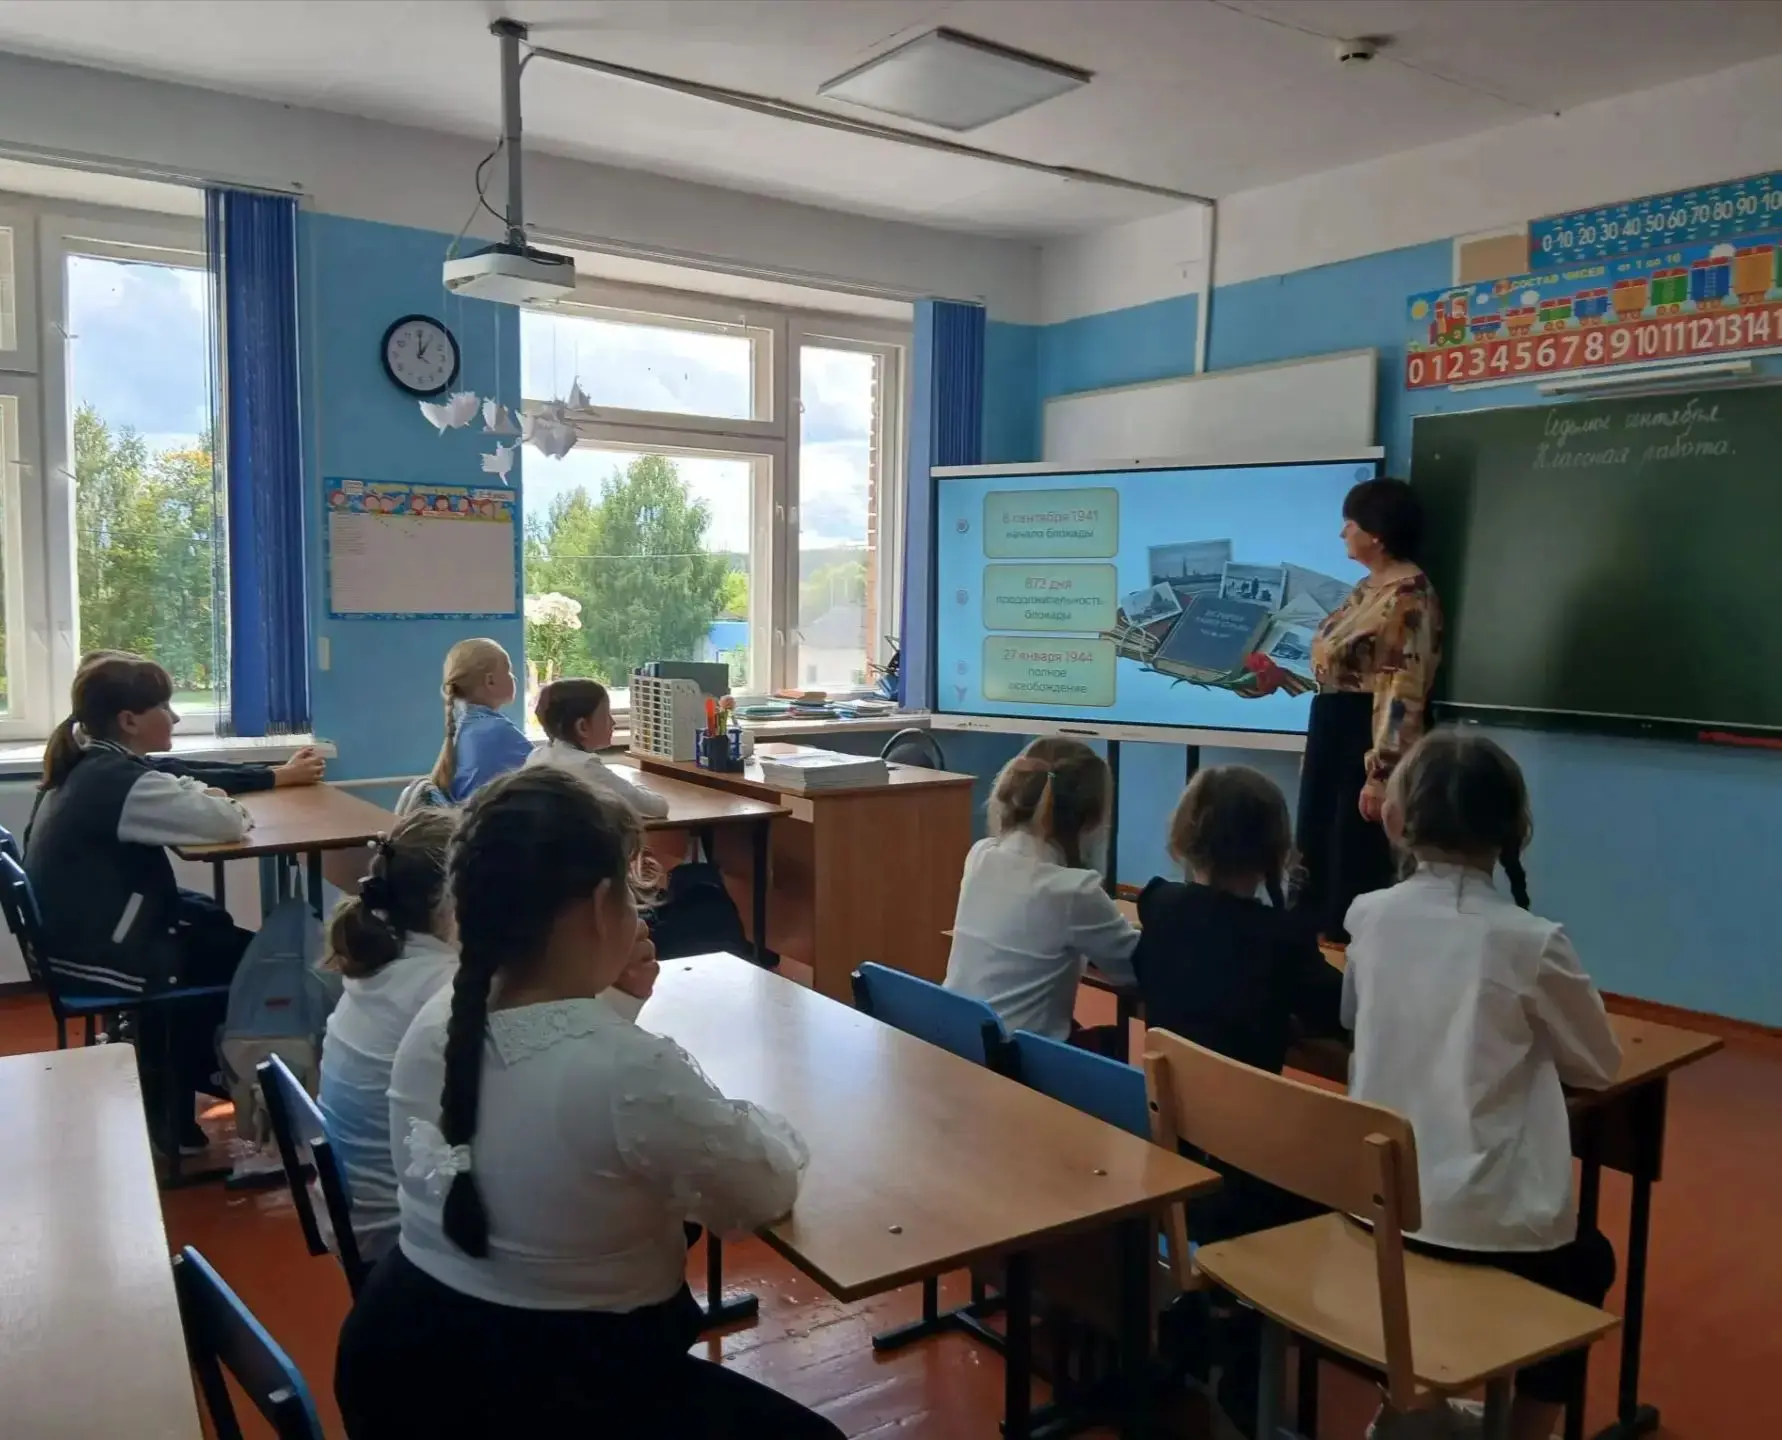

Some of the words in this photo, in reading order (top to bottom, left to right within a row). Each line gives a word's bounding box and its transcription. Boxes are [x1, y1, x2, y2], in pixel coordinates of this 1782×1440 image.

[1542, 235, 1553, 253] 0
[1556, 231, 1574, 248] 10
[1578, 226, 1596, 246] 20
[1600, 221, 1619, 241] 30
[1622, 217, 1641, 236] 40
[1645, 213, 1665, 233] 50
[1668, 208, 1687, 229] 60
[1691, 204, 1710, 224] 70
[1713, 200, 1733, 220] 80
[1736, 195, 1758, 216] 90
[1408, 358, 1425, 384] 0
[1431, 355, 1443, 380] 1
[1447, 351, 1464, 379] 2
[1468, 347, 1486, 376] 3
[1490, 345, 1509, 372] 4
[1513, 341, 1533, 370] 5
[1536, 338, 1557, 367] 6
[1561, 335, 1580, 365] 7
[1584, 331, 1604, 361] 8
[1610, 328, 1631, 359] 9
[1633, 325, 1659, 356] 10
[1661, 321, 1686, 352] 11
[1688, 317, 1715, 349] 12
[1715, 313, 1743, 346] 13
[1743, 308, 1770, 343] 14
